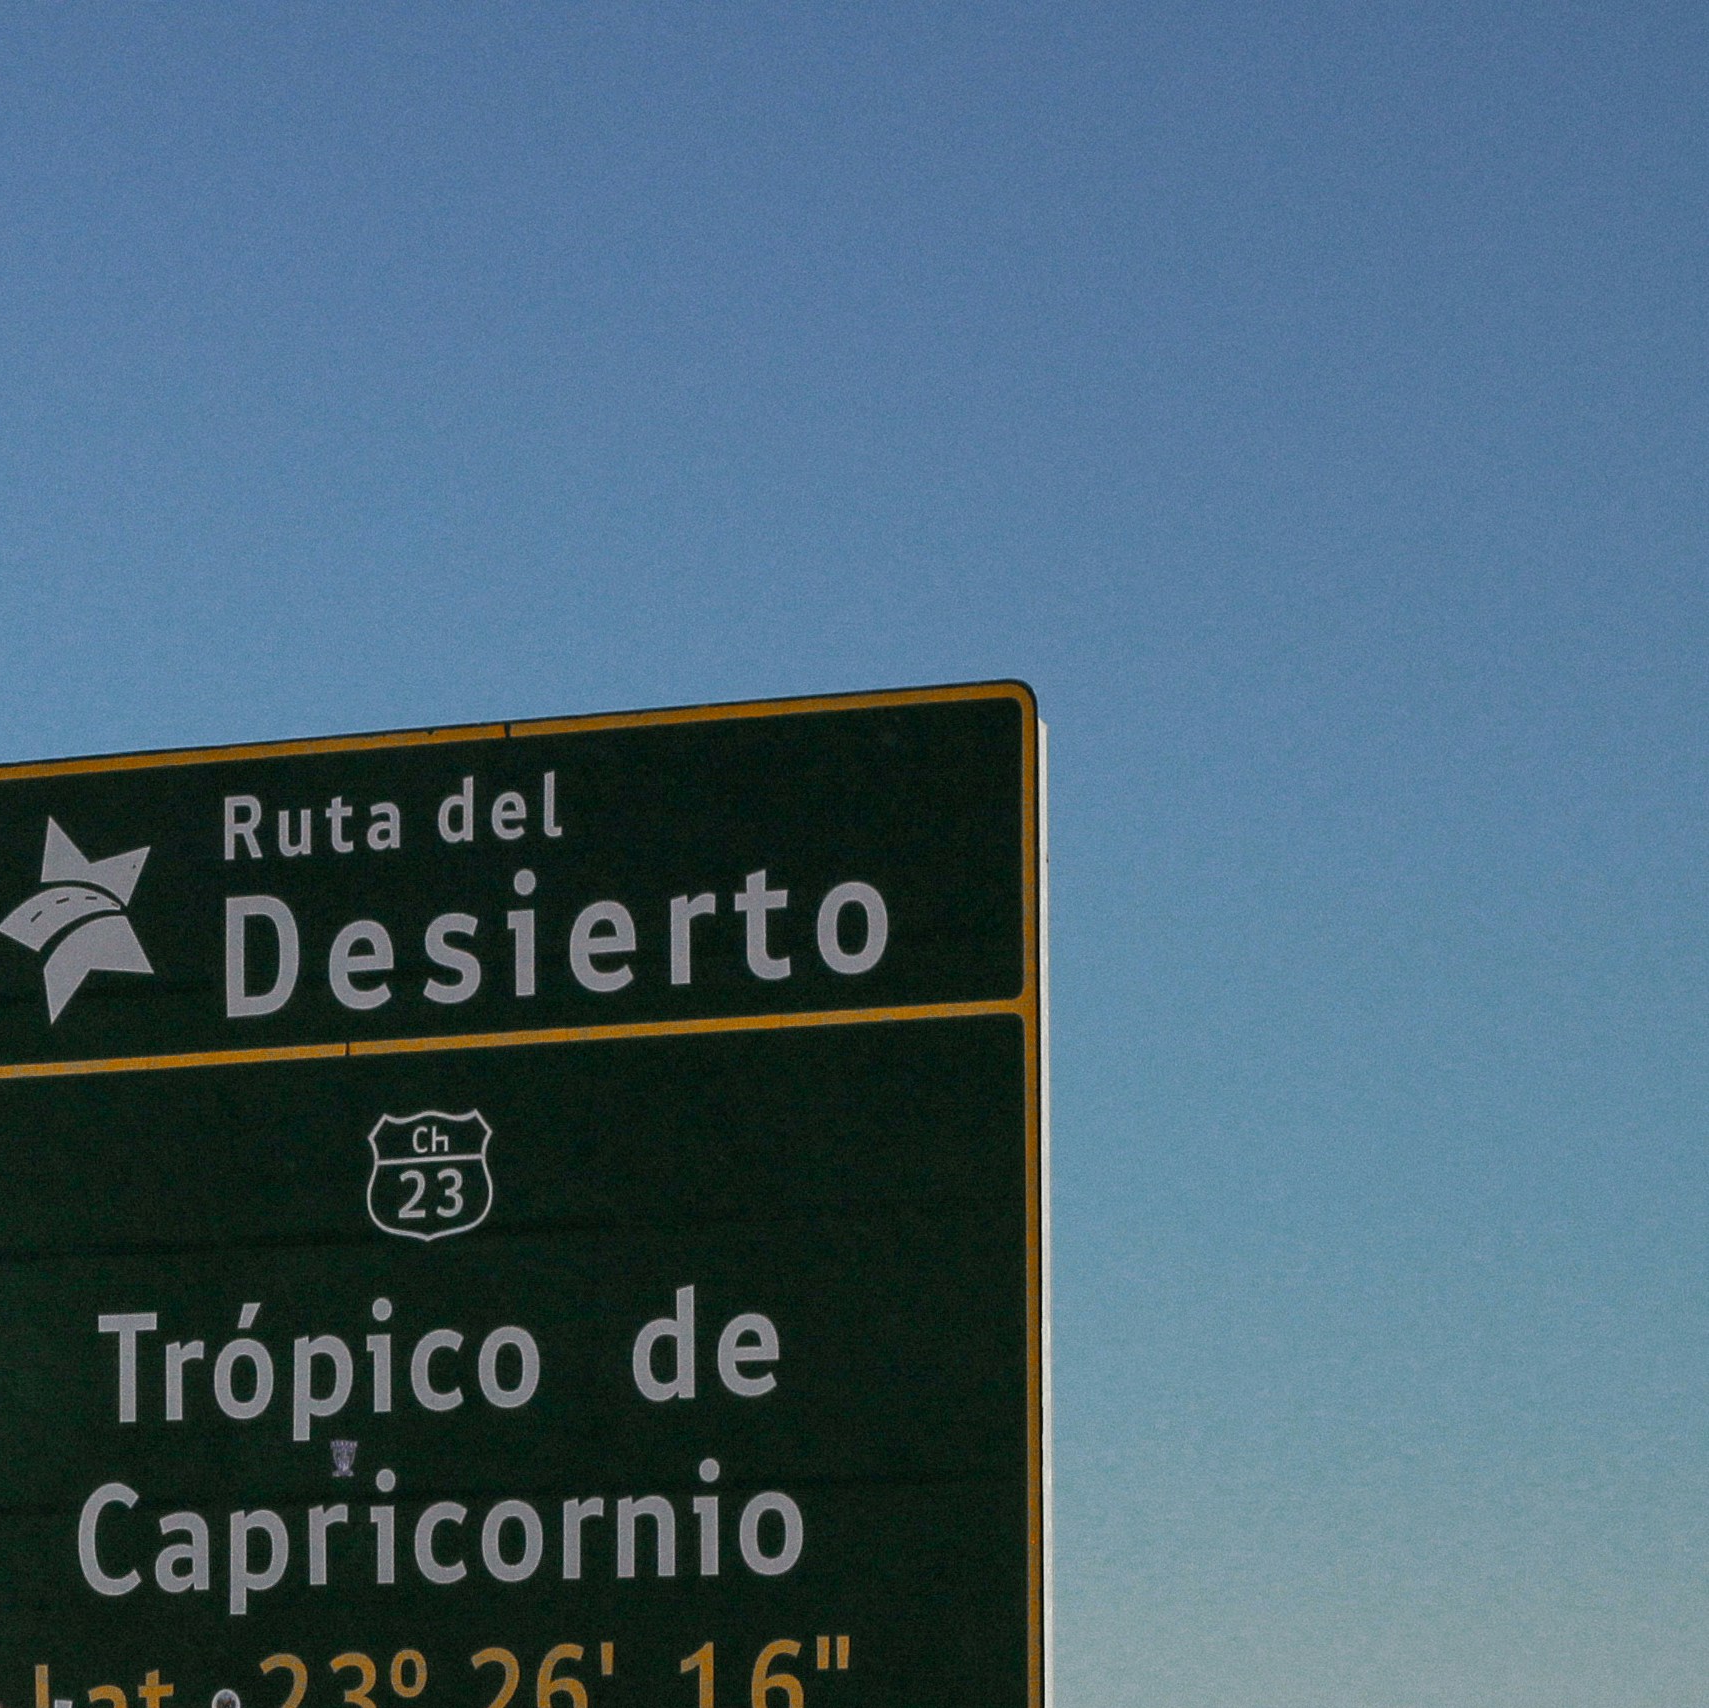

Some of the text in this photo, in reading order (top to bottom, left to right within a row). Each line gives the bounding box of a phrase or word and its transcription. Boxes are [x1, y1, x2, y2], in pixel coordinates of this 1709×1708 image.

[224, 770, 563, 861] Ruta del
[225, 868, 889, 1018] Desierto
[398, 1168, 464, 1219] 23
[412, 1125, 449, 1154] Ch
[97, 1284, 780, 1442] Trópico de
[77, 1458, 804, 1615] Capricornio
